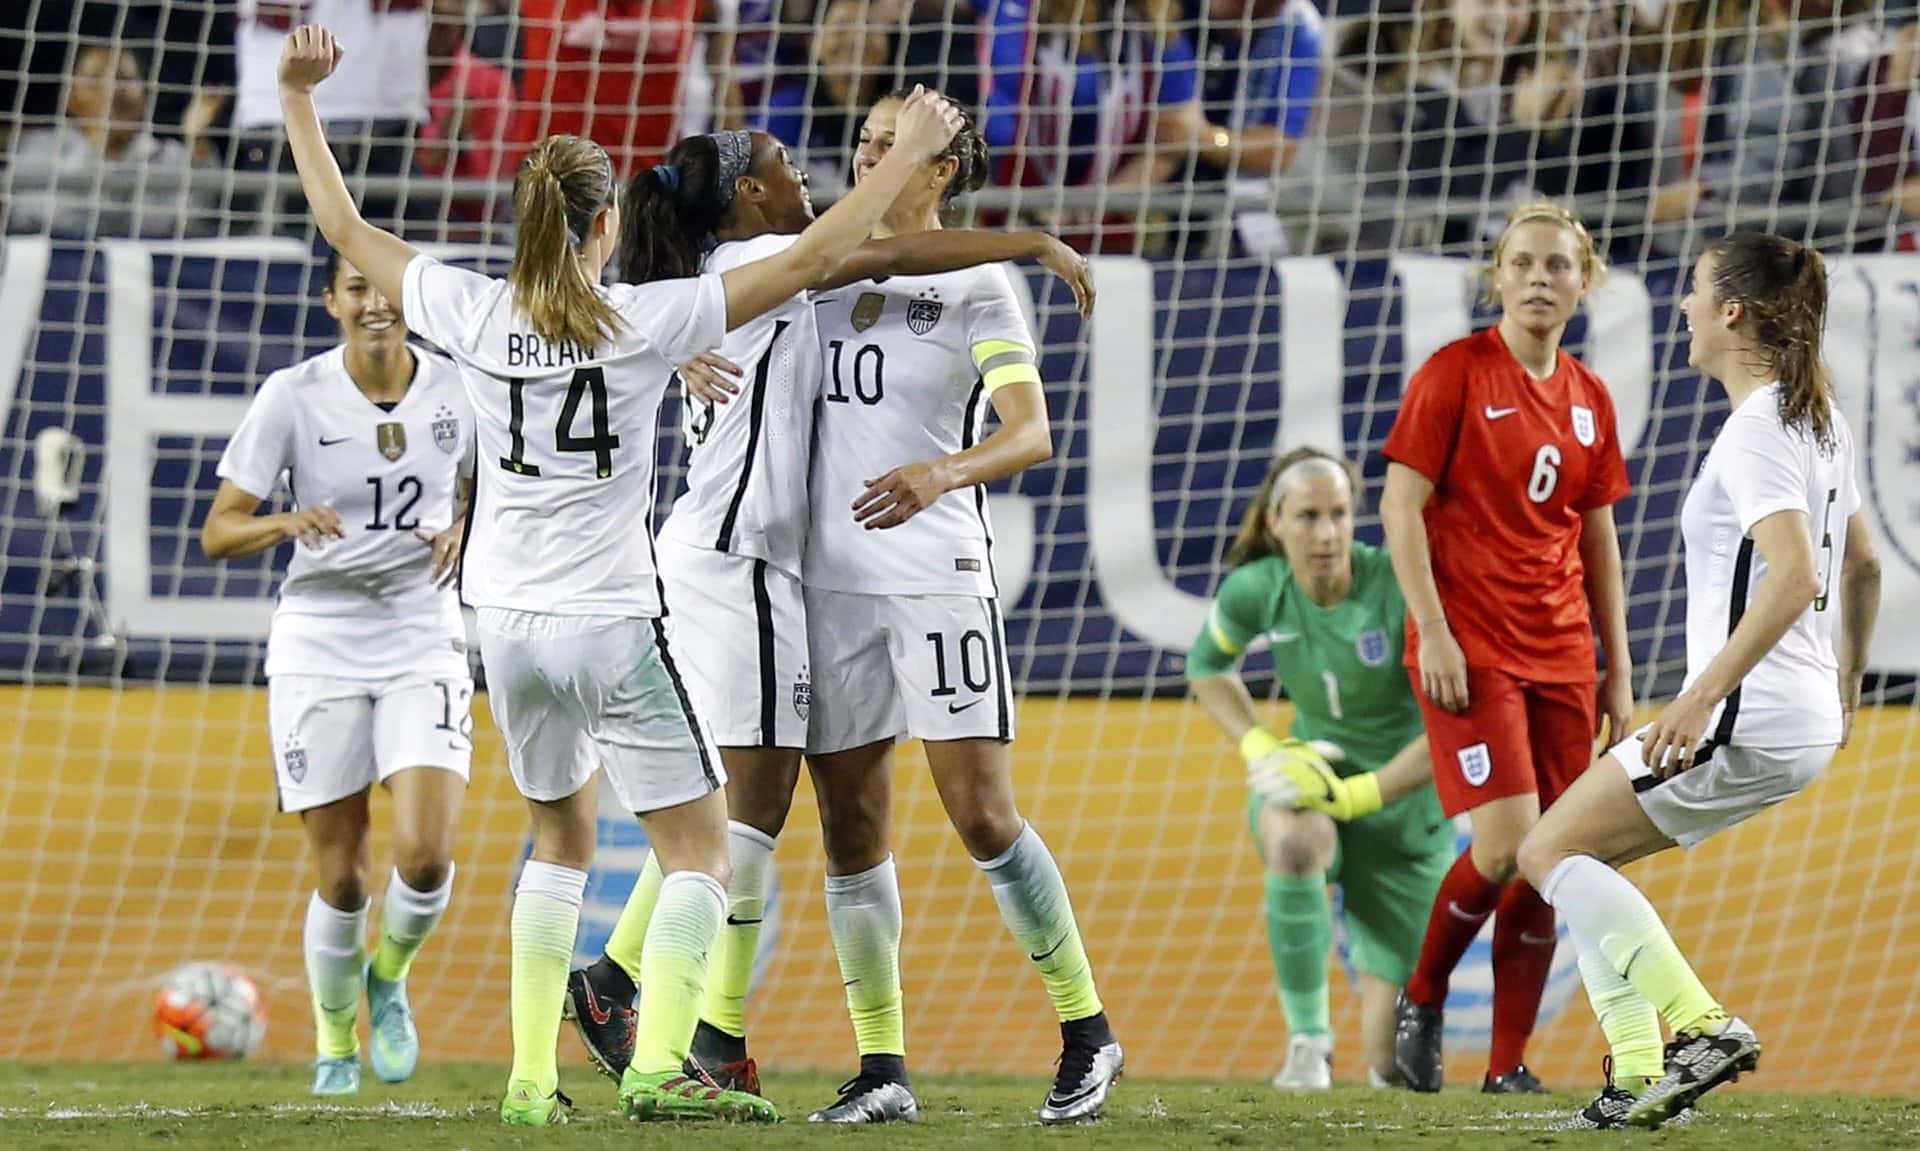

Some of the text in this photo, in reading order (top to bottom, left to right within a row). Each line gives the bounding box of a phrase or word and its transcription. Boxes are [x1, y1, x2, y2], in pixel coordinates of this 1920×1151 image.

[826, 340, 885, 406] 10
[499, 366, 620, 480] 14
[365, 475, 422, 531] 12
[1527, 443, 1562, 503] 6
[926, 629, 991, 696] 10
[1320, 670, 1343, 720] 1
